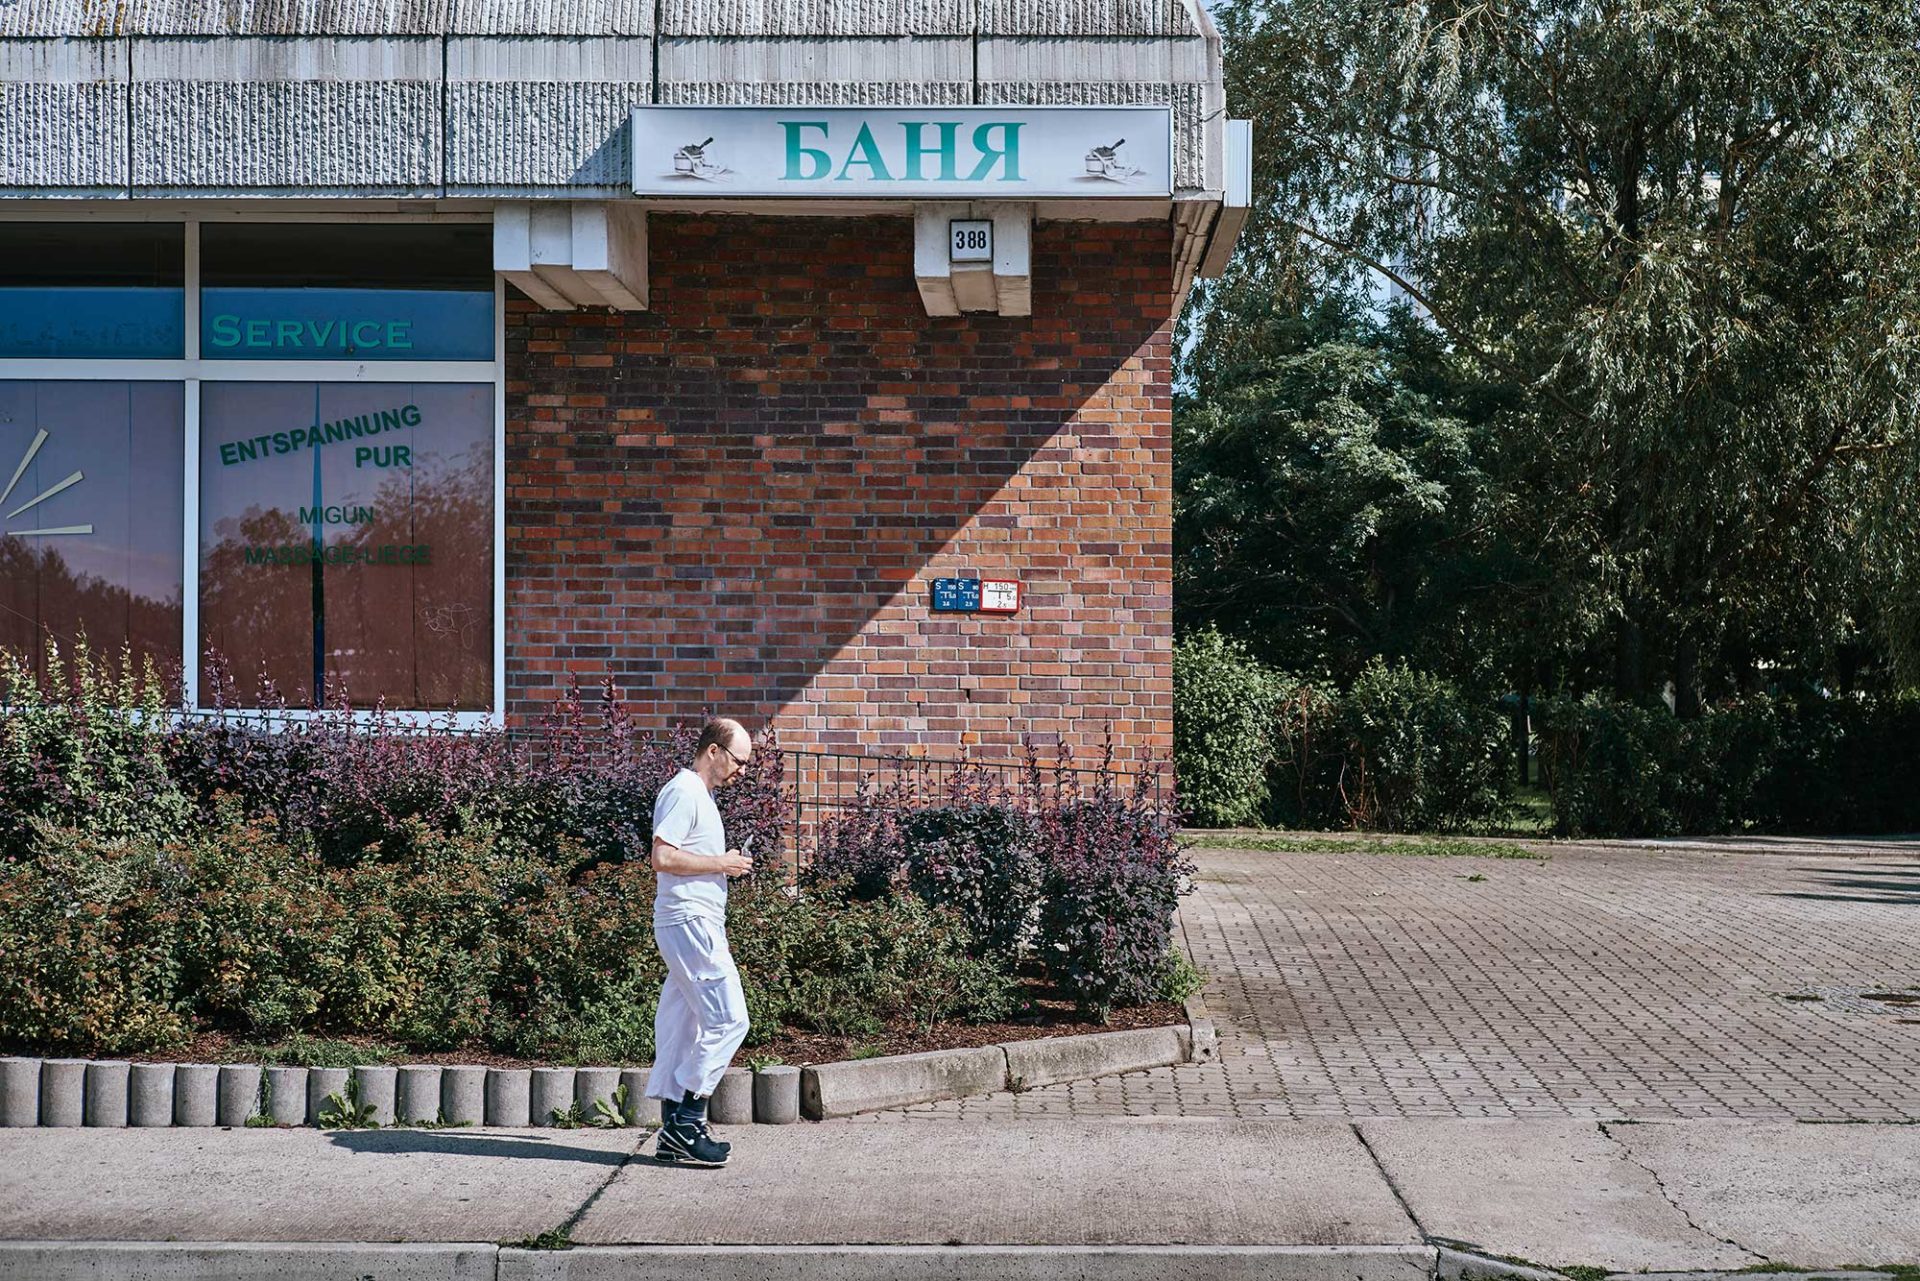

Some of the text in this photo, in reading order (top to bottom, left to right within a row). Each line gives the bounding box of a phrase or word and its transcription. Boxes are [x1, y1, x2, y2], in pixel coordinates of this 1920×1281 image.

[777, 120, 1027, 182] БАНЯ
[956, 230, 987, 249] 388
[211, 314, 414, 349] SERVICE
[219, 404, 422, 466] ENTSPANNUNG
[355, 445, 412, 468] PUR
[299, 506, 375, 524] MIGUN
[245, 545, 432, 565] MASSAGE-LIEGE
[935, 582, 942, 590] S
[958, 582, 964, 590] S
